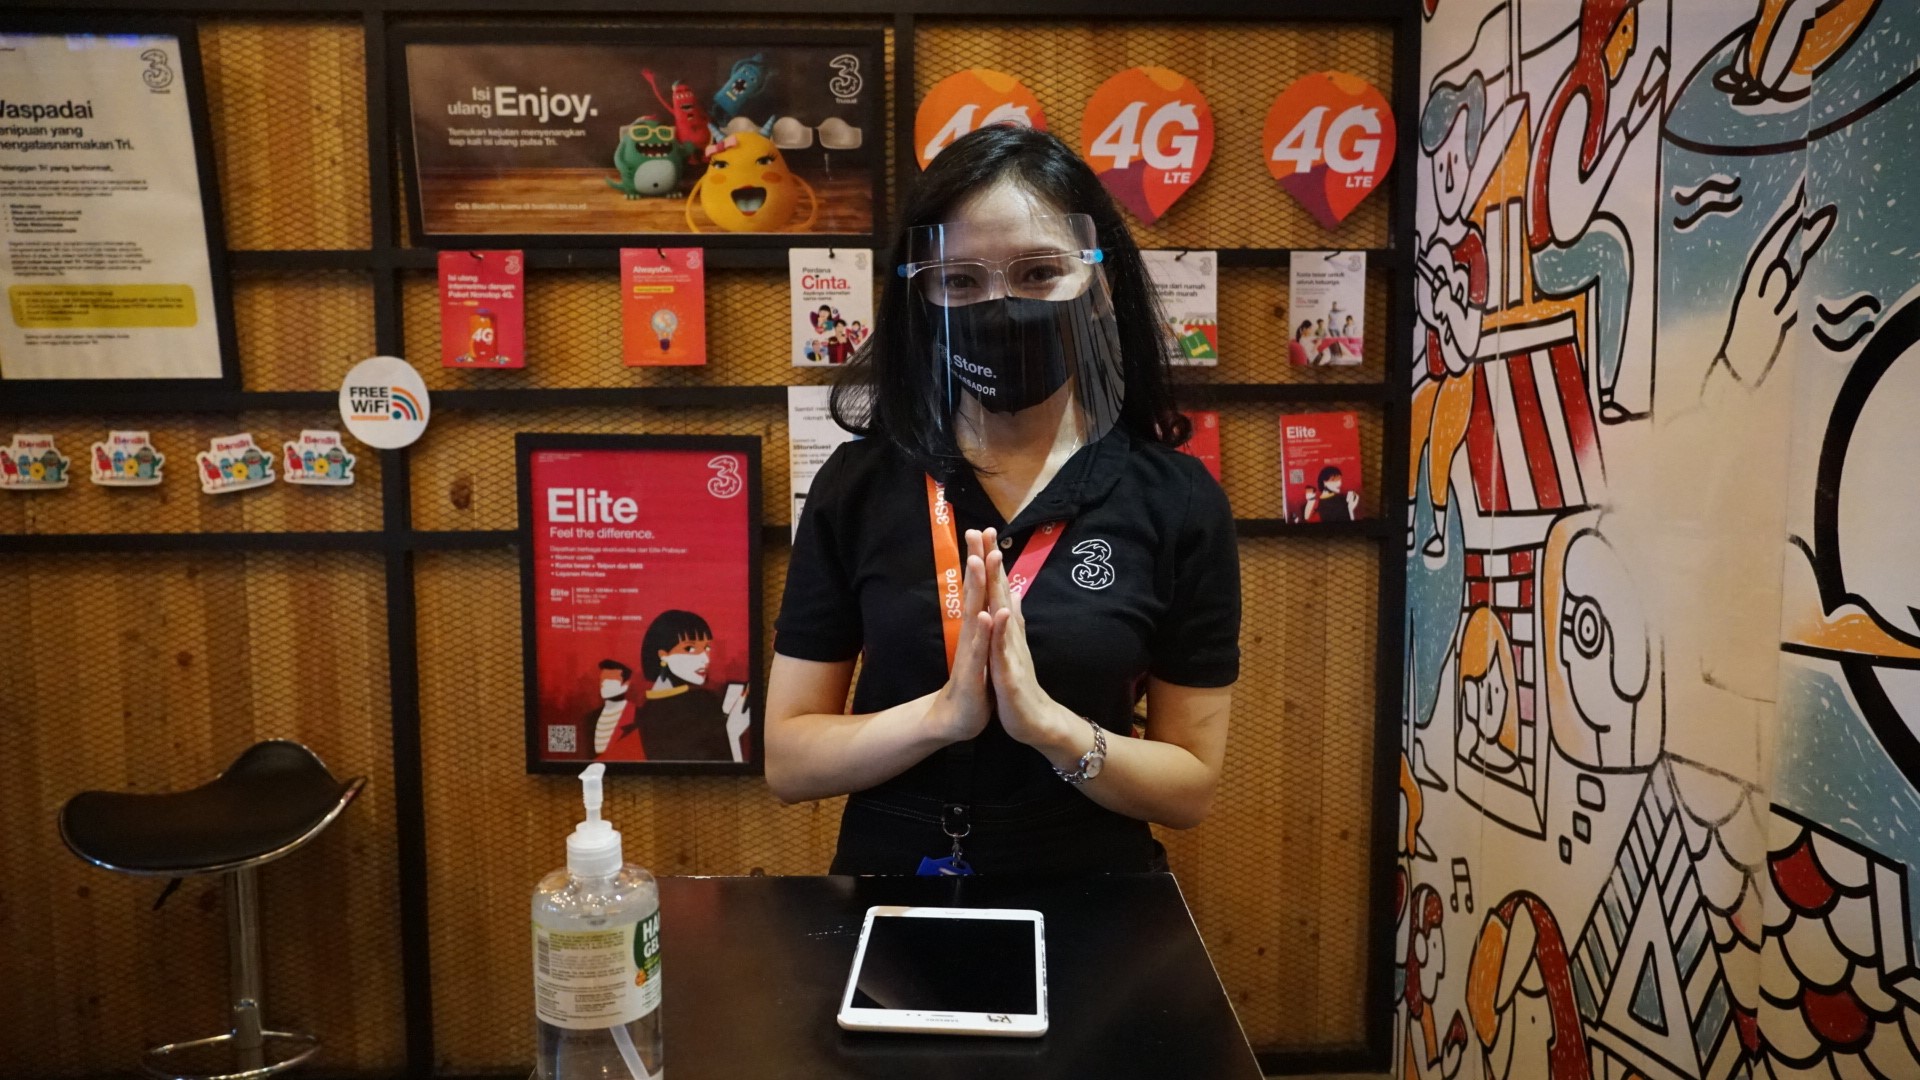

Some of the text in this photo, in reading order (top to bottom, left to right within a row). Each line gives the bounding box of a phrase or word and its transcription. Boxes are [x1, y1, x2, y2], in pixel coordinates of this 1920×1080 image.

[472, 86, 490, 100] Isi
[0, 100, 93, 122] aspadai
[447, 102, 491, 118] ulang
[495, 86, 598, 123] Enjoy.
[51, 127, 83, 137] yang
[448, 128, 486, 136] Temukan
[521, 129, 586, 138] menyenangkan
[1090, 99, 1200, 169] 4G
[1271, 104, 1382, 174] 4G
[495, 138, 518, 147] ulang
[1163, 172, 1191, 184] LTE
[1346, 175, 1373, 188] LTE
[802, 275, 851, 290] Cinta.
[953, 354, 997, 378] Store.
[349, 386, 389, 398] FREE
[351, 400, 389, 413] WiFi
[1286, 426, 1316, 439] Elite
[547, 487, 638, 524] Elite
[549, 526, 655, 540] Feel the difference.
[1072, 538, 1115, 590] 3
[945, 568, 962, 618] 3Store
